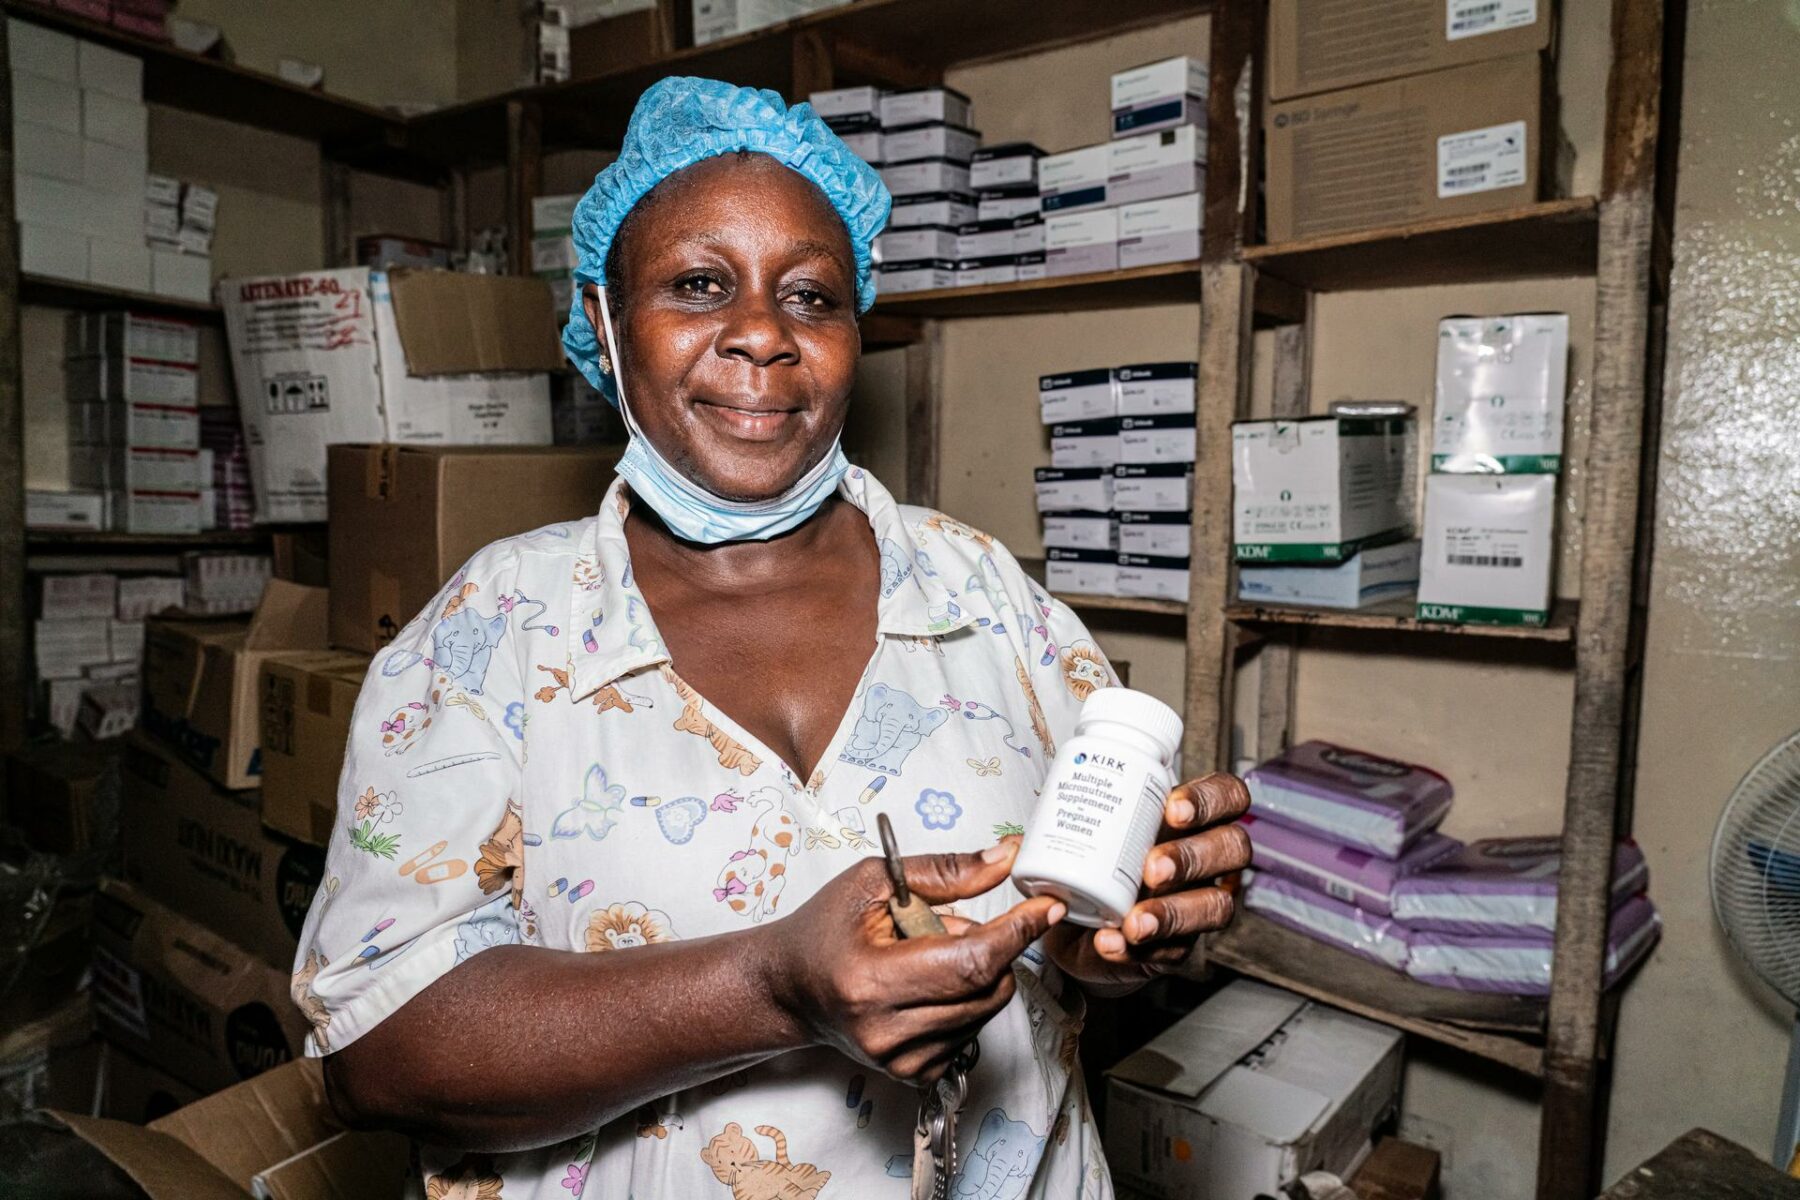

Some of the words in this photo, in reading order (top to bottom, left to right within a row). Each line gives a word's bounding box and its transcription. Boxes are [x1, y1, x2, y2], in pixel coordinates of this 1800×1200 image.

[1091, 753, 1126, 771] KIRK
[1072, 772, 1113, 789] Multiple
[1057, 781, 1123, 806] Micronutrient
[1057, 792, 1115, 814] Supplement
[1056, 808, 1102, 828] Pregnant
[1056, 818, 1093, 837] Women
